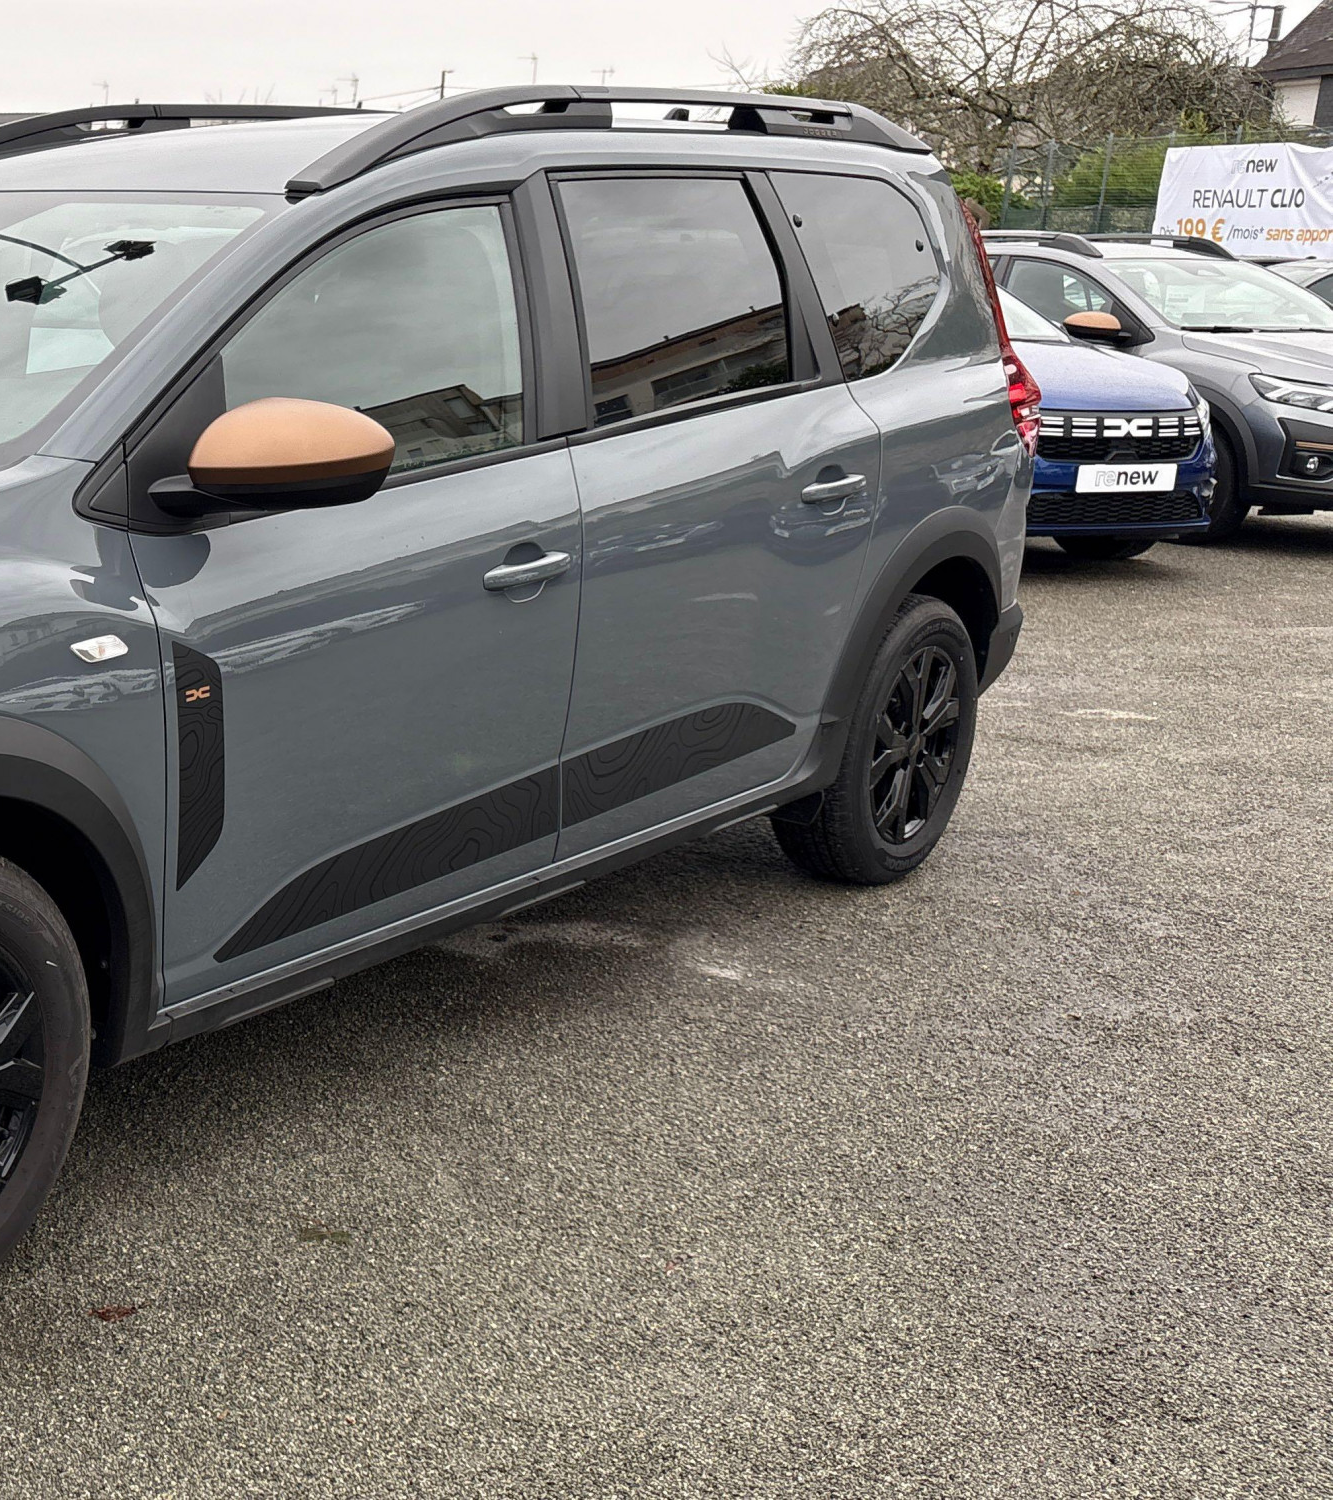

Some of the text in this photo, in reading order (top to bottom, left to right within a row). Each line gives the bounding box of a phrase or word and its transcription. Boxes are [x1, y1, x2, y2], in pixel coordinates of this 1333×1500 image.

[1192, 187, 1305, 209] RENAULT CLIO
[1211, 218, 1226, 242] €
[1265, 228, 1295, 241] sans
[1095, 470, 1159, 486] renew
